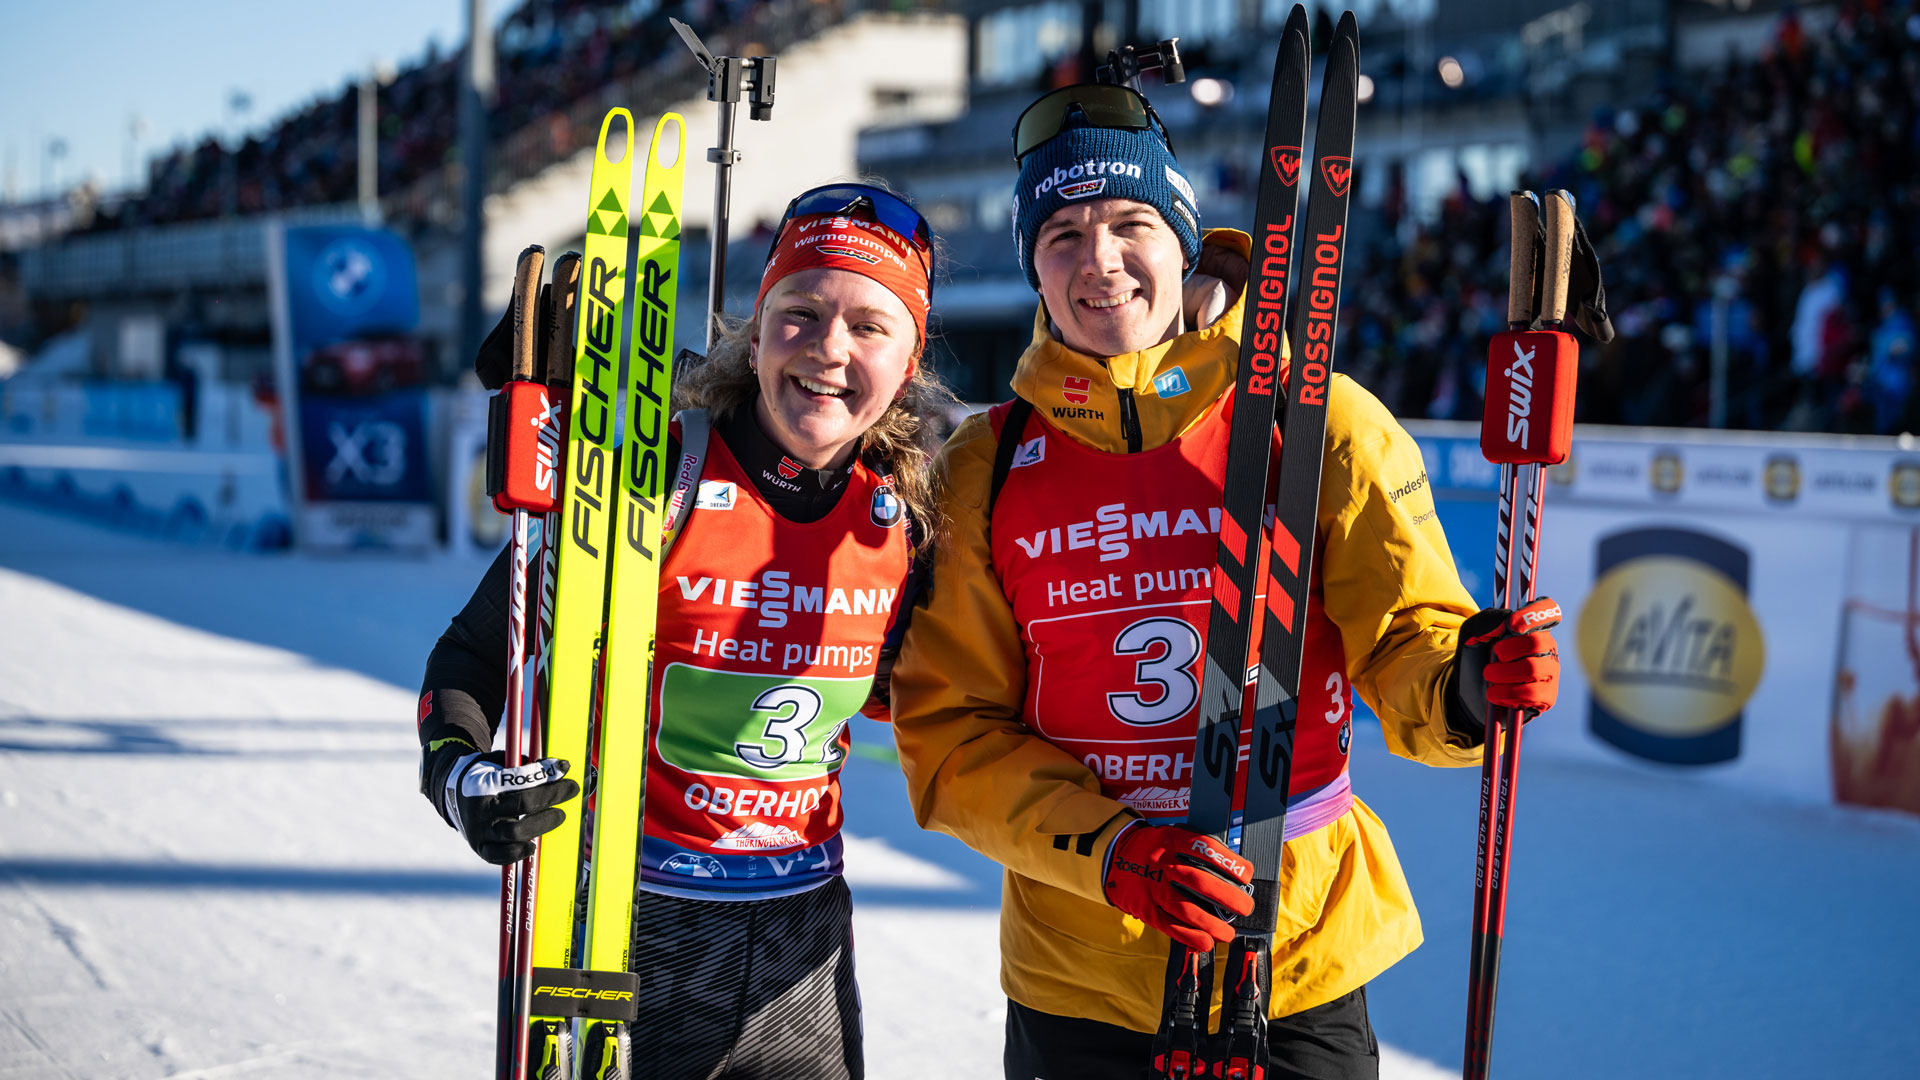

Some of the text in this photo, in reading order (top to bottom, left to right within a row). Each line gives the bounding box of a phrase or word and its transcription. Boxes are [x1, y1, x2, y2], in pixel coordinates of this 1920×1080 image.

[1035, 159, 1142, 200] robotron
[794, 232, 907, 272] Wärmepumpen
[1248, 214, 1292, 396] ROSSIGNOL
[1300, 225, 1342, 406] ROSSIGNOL
[572, 256, 618, 560] FISCHER
[627, 258, 672, 562] FISCHER
[1052, 407, 1105, 421] WÜRTH
[325, 419, 408, 485] X3
[762, 469, 803, 493] WÜRTH
[1014, 502, 1224, 563] VIESSMA
[676, 570, 897, 629] VIESSMANN
[1047, 566, 1215, 607] Heat pum
[692, 628, 775, 663] Heat
[782, 642, 874, 673] pumps
[1105, 615, 1203, 728] 3
[735, 684, 823, 770] 3
[1324, 671, 1346, 724] 3
[533, 985, 634, 1001] FISCHER
